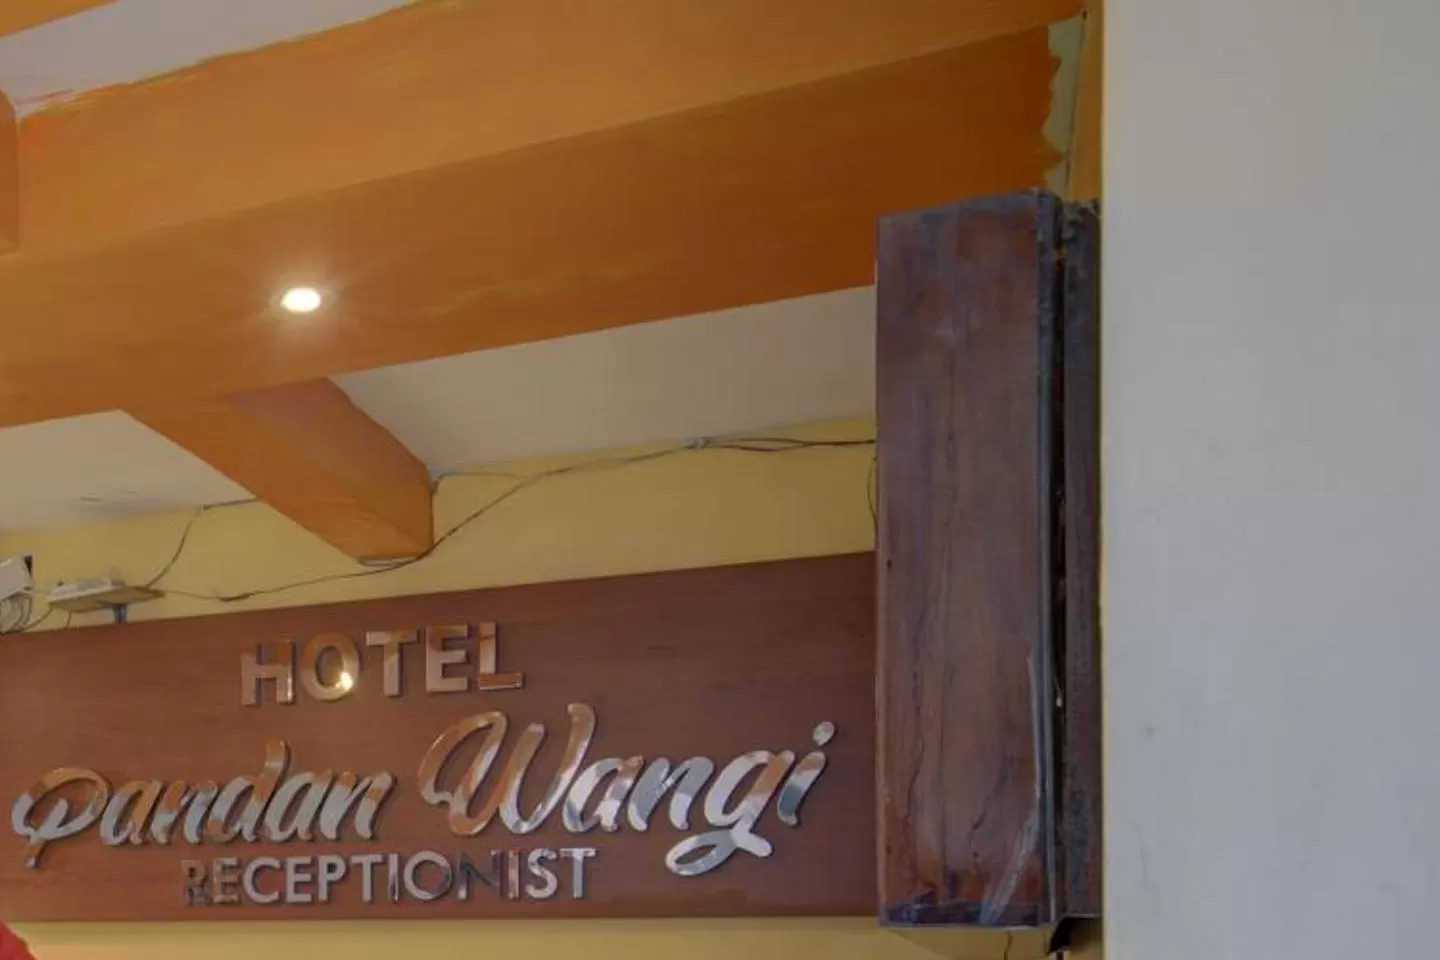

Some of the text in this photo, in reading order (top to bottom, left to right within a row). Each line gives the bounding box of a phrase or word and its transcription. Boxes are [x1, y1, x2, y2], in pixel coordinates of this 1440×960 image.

[240, 621, 525, 707] HOTEL
[10, 702, 839, 878] Pandan Wangi
[180, 846, 597, 907] RECEPTIONIST
